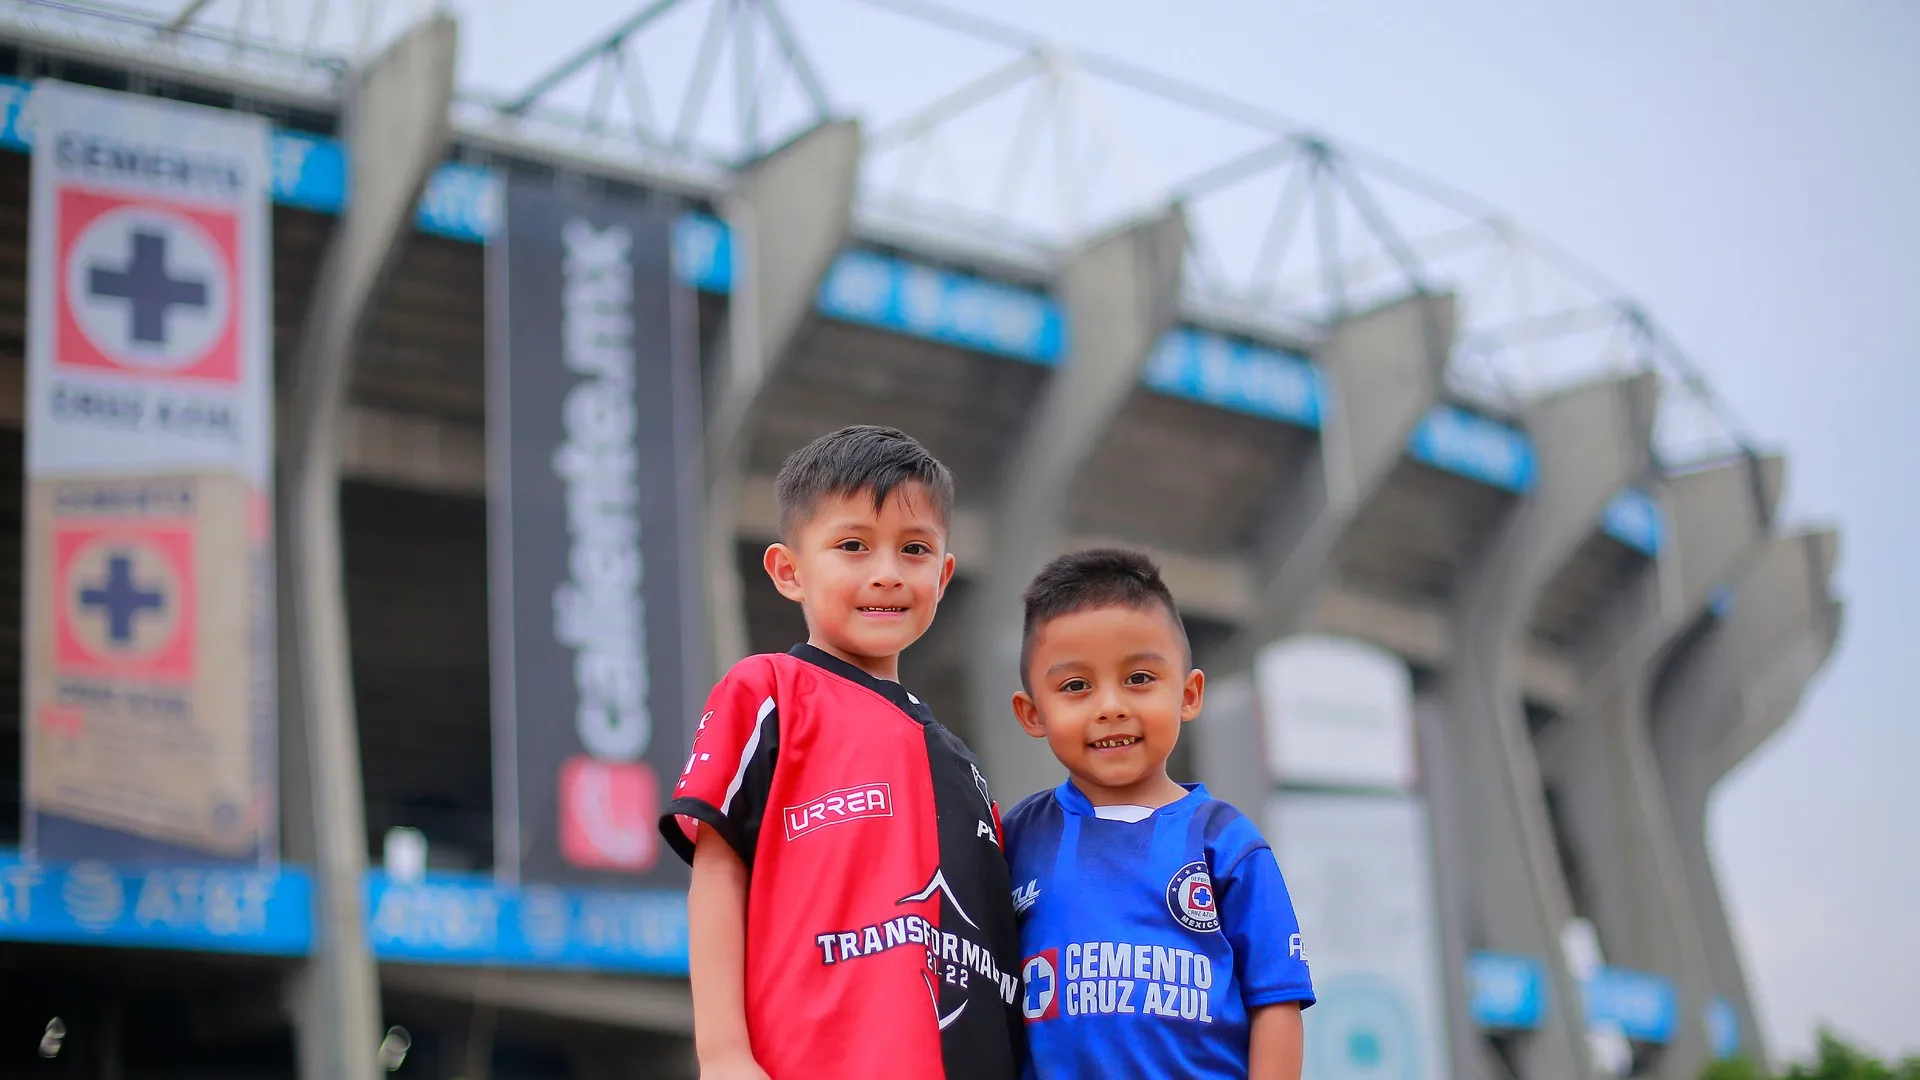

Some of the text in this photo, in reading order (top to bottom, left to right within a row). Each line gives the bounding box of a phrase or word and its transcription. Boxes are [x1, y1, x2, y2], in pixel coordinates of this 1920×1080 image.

[551, 214, 651, 761] caliente.mx
[790, 789, 886, 831] URREA
[134, 866, 276, 936] AT&T
[1181, 914, 1218, 928] MEXICO
[1065, 941, 1213, 990] CEMENTO
[1066, 979, 1213, 1024] CRUZ AZUL
